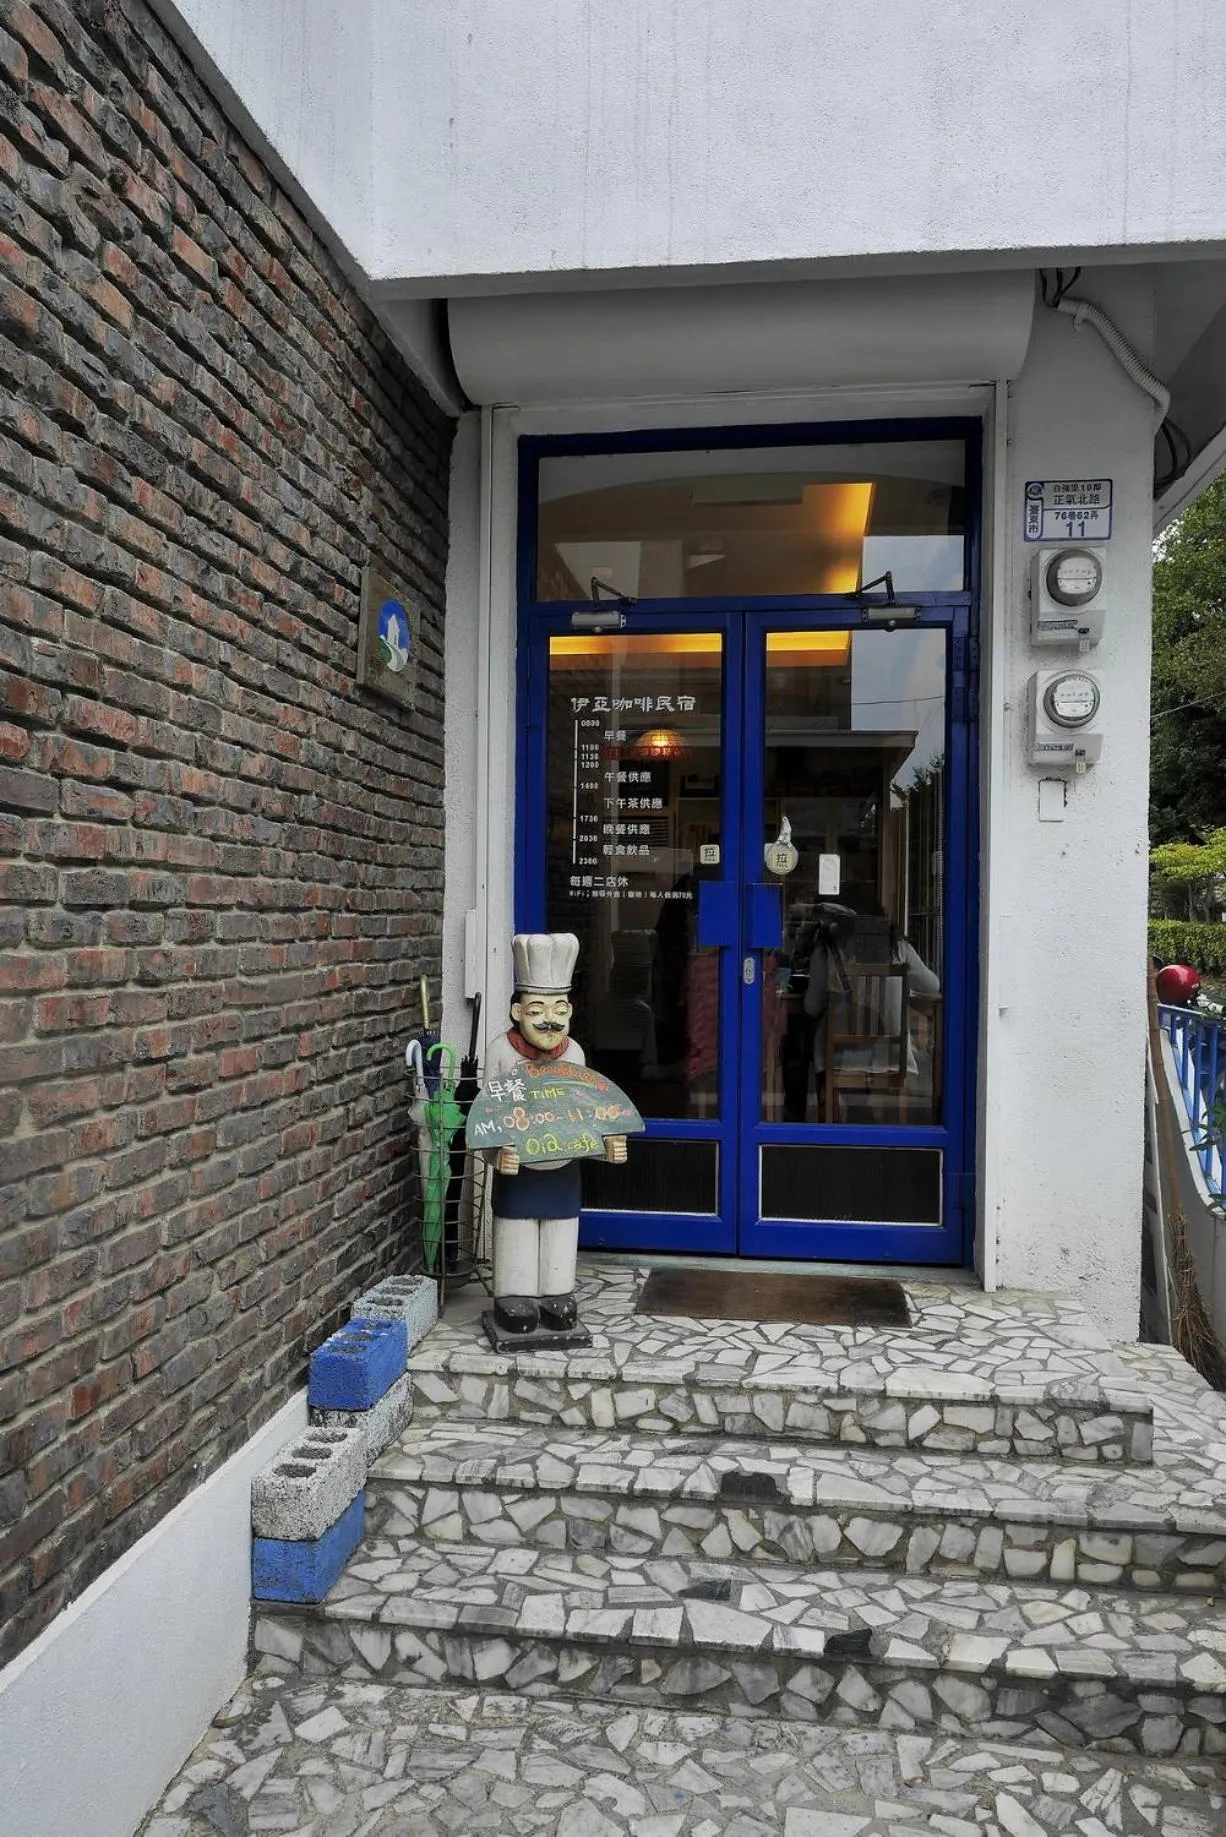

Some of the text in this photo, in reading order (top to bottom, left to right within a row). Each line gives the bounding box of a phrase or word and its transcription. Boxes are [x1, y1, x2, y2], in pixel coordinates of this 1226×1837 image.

[1065, 521, 1085, 537] 11
[571, 695, 697, 713] 伊亞咖啡民宿
[604, 730, 627, 742] 早餐
[604, 771, 652, 783] 午餐供應
[604, 797, 663, 809] 下午茶供應
[580, 815, 599, 823] 1730
[603, 824, 651, 835] 晚餐供應
[488, 1078, 528, 1102] 早餐
